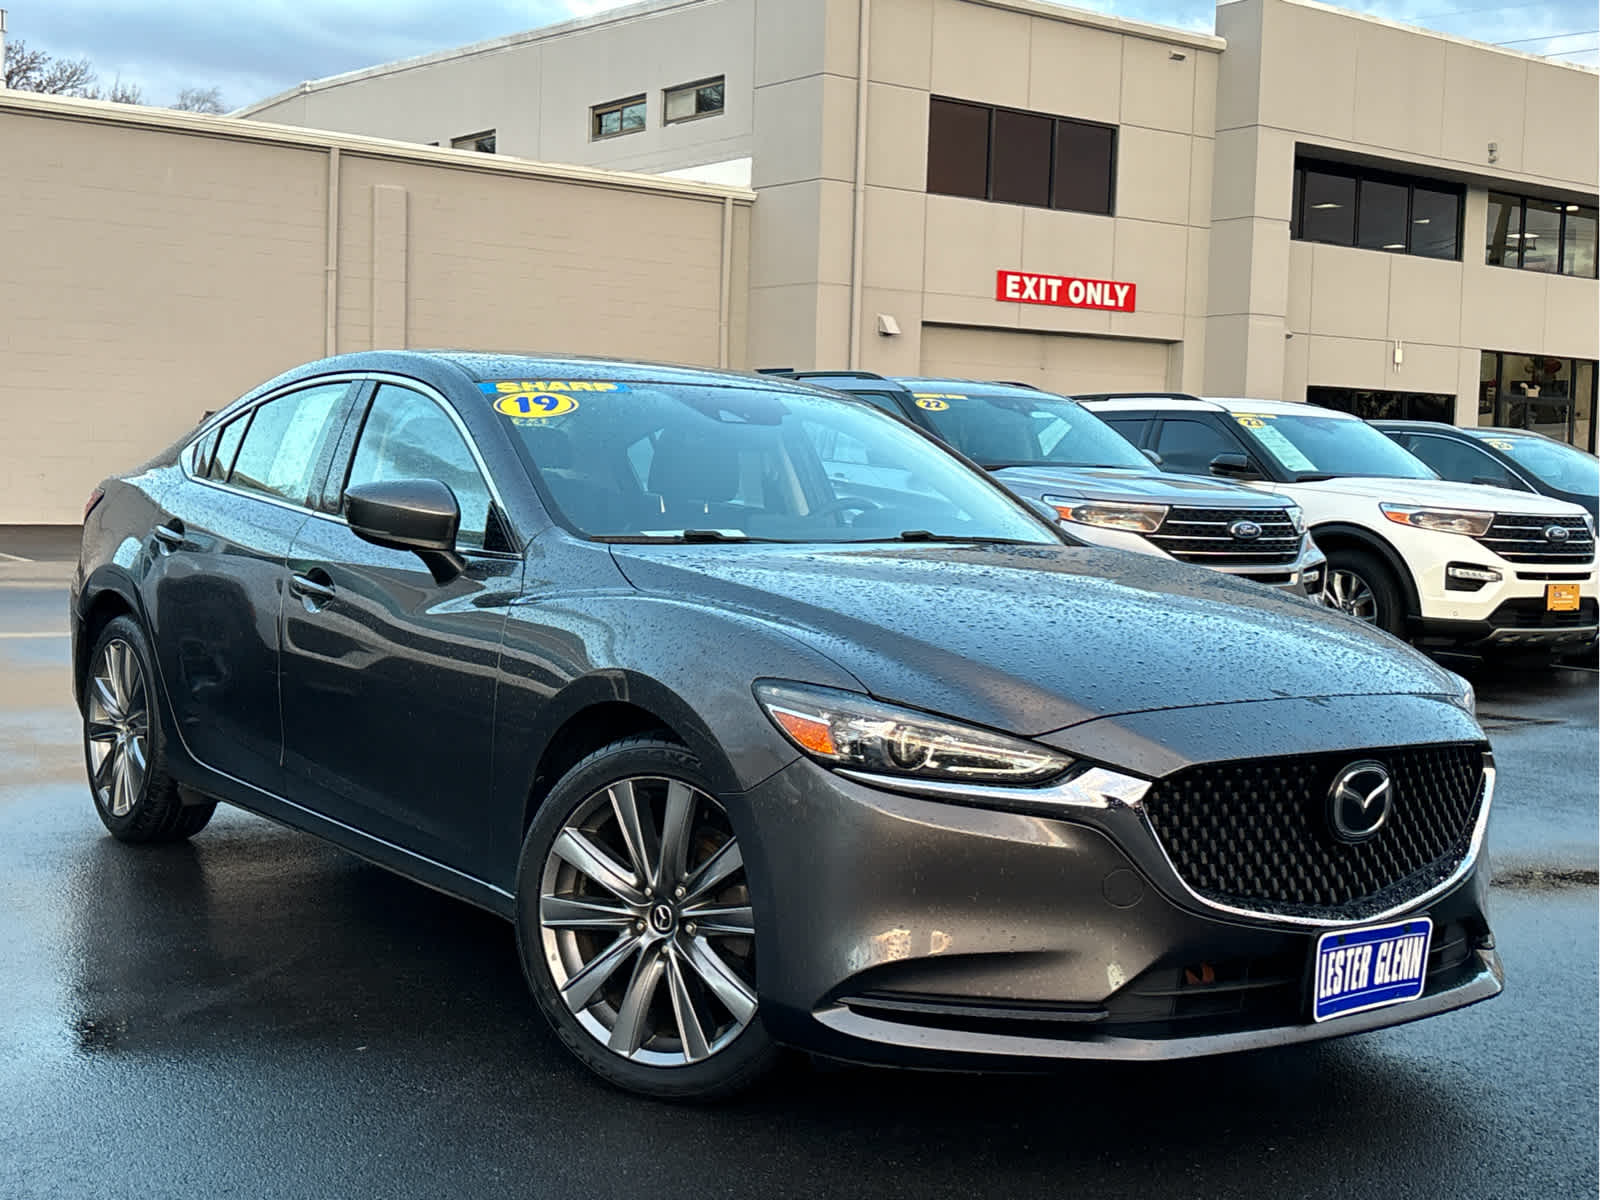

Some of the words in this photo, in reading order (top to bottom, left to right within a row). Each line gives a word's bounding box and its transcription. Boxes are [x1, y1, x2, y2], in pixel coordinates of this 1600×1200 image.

[1005, 274, 1062, 302] EXIT
[1068, 280, 1130, 307] ONLY
[495, 381, 618, 393] SHARP
[514, 395, 559, 413] 19
[1319, 945, 1373, 999] LESTER
[1373, 936, 1425, 985] GLENN
